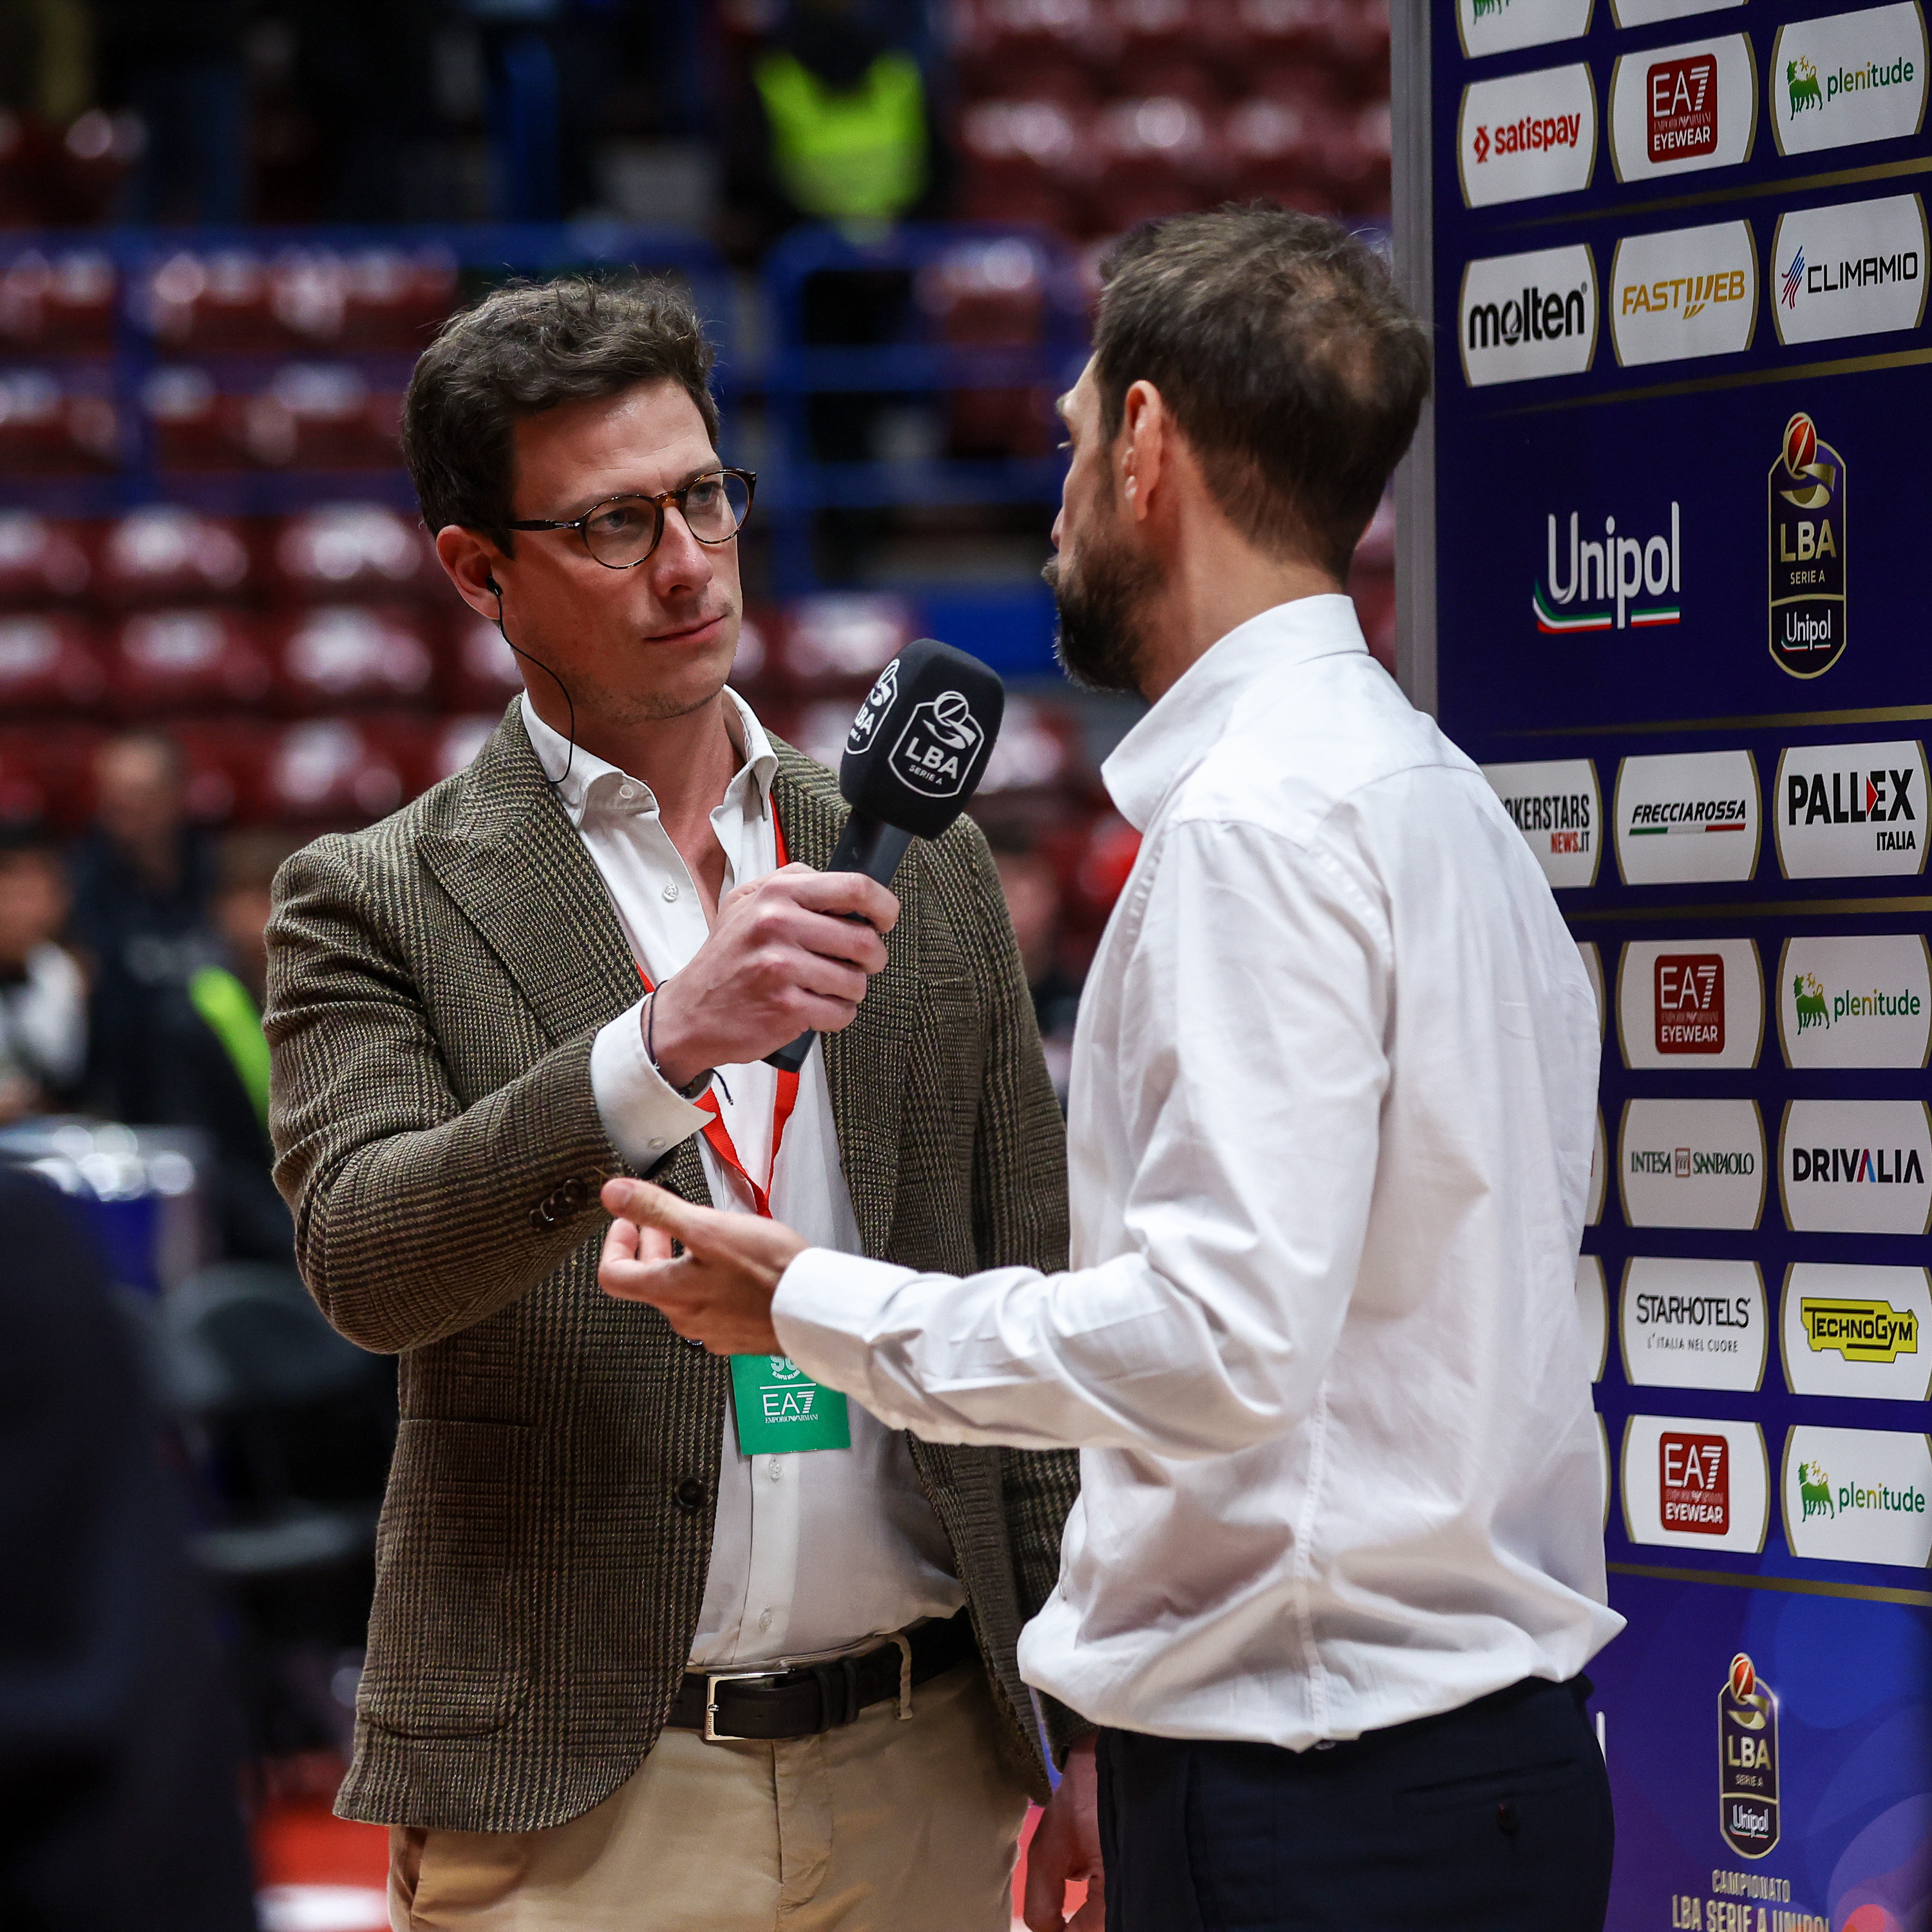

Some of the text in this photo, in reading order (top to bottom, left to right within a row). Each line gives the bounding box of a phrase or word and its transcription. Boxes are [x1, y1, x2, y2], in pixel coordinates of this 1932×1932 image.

[1653, 66, 1710, 118] EA7
[1827, 57, 1915, 101] plenitude
[1495, 112, 1580, 155] satispay
[1654, 126, 1710, 151] EYEWEAR
[1807, 252, 1918, 294] CLIMAMIO
[1622, 270, 1745, 320] FASTWEB
[1469, 285, 1585, 350] molten
[1780, 518, 1837, 562] LBA
[1548, 500, 1680, 629] Unipol
[1790, 569, 1826, 585] SERIE A
[1786, 609, 1831, 651] Unipol
[905, 737, 959, 780] LBA
[909, 764, 943, 786] SERIE A
[1501, 794, 1589, 830] OKERSTARS
[1631, 799, 1747, 825] FRECCIAROSSA
[1788, 769, 1916, 826] PALLEX
[1551, 831, 1590, 855] NEWS.IT
[1876, 830, 1917, 851] ITALIA
[1661, 965, 1718, 1010] EA7
[1834, 989, 1921, 1023] plenitude
[1662, 1025, 1718, 1043] EYEWEAR
[1631, 1150, 1755, 1175] INTESA SANPAOLO
[1792, 1147, 1925, 1184] DRIVALIA
[1636, 1293, 1750, 1329] STARHOTELS
[762, 1390, 815, 1416] EA7
[764, 1414, 819, 1424] EMPORIO ARMANI
[1664, 1443, 1723, 1490] EA7
[1665, 1501, 1724, 1524] EYEWEAR
[1839, 1482, 1926, 1514] plenitude
[1727, 1735, 1771, 1770] LBA
[1735, 1774, 1757, 1787] SERIE
[1732, 1803, 1770, 1839] Unipol
[1711, 1868, 1792, 1904] CAMPIONATO
[1672, 1895, 1703, 1931] LBA
[1706, 1899, 1753, 1932] SERIE
[1756, 1907, 1768, 1932] A
